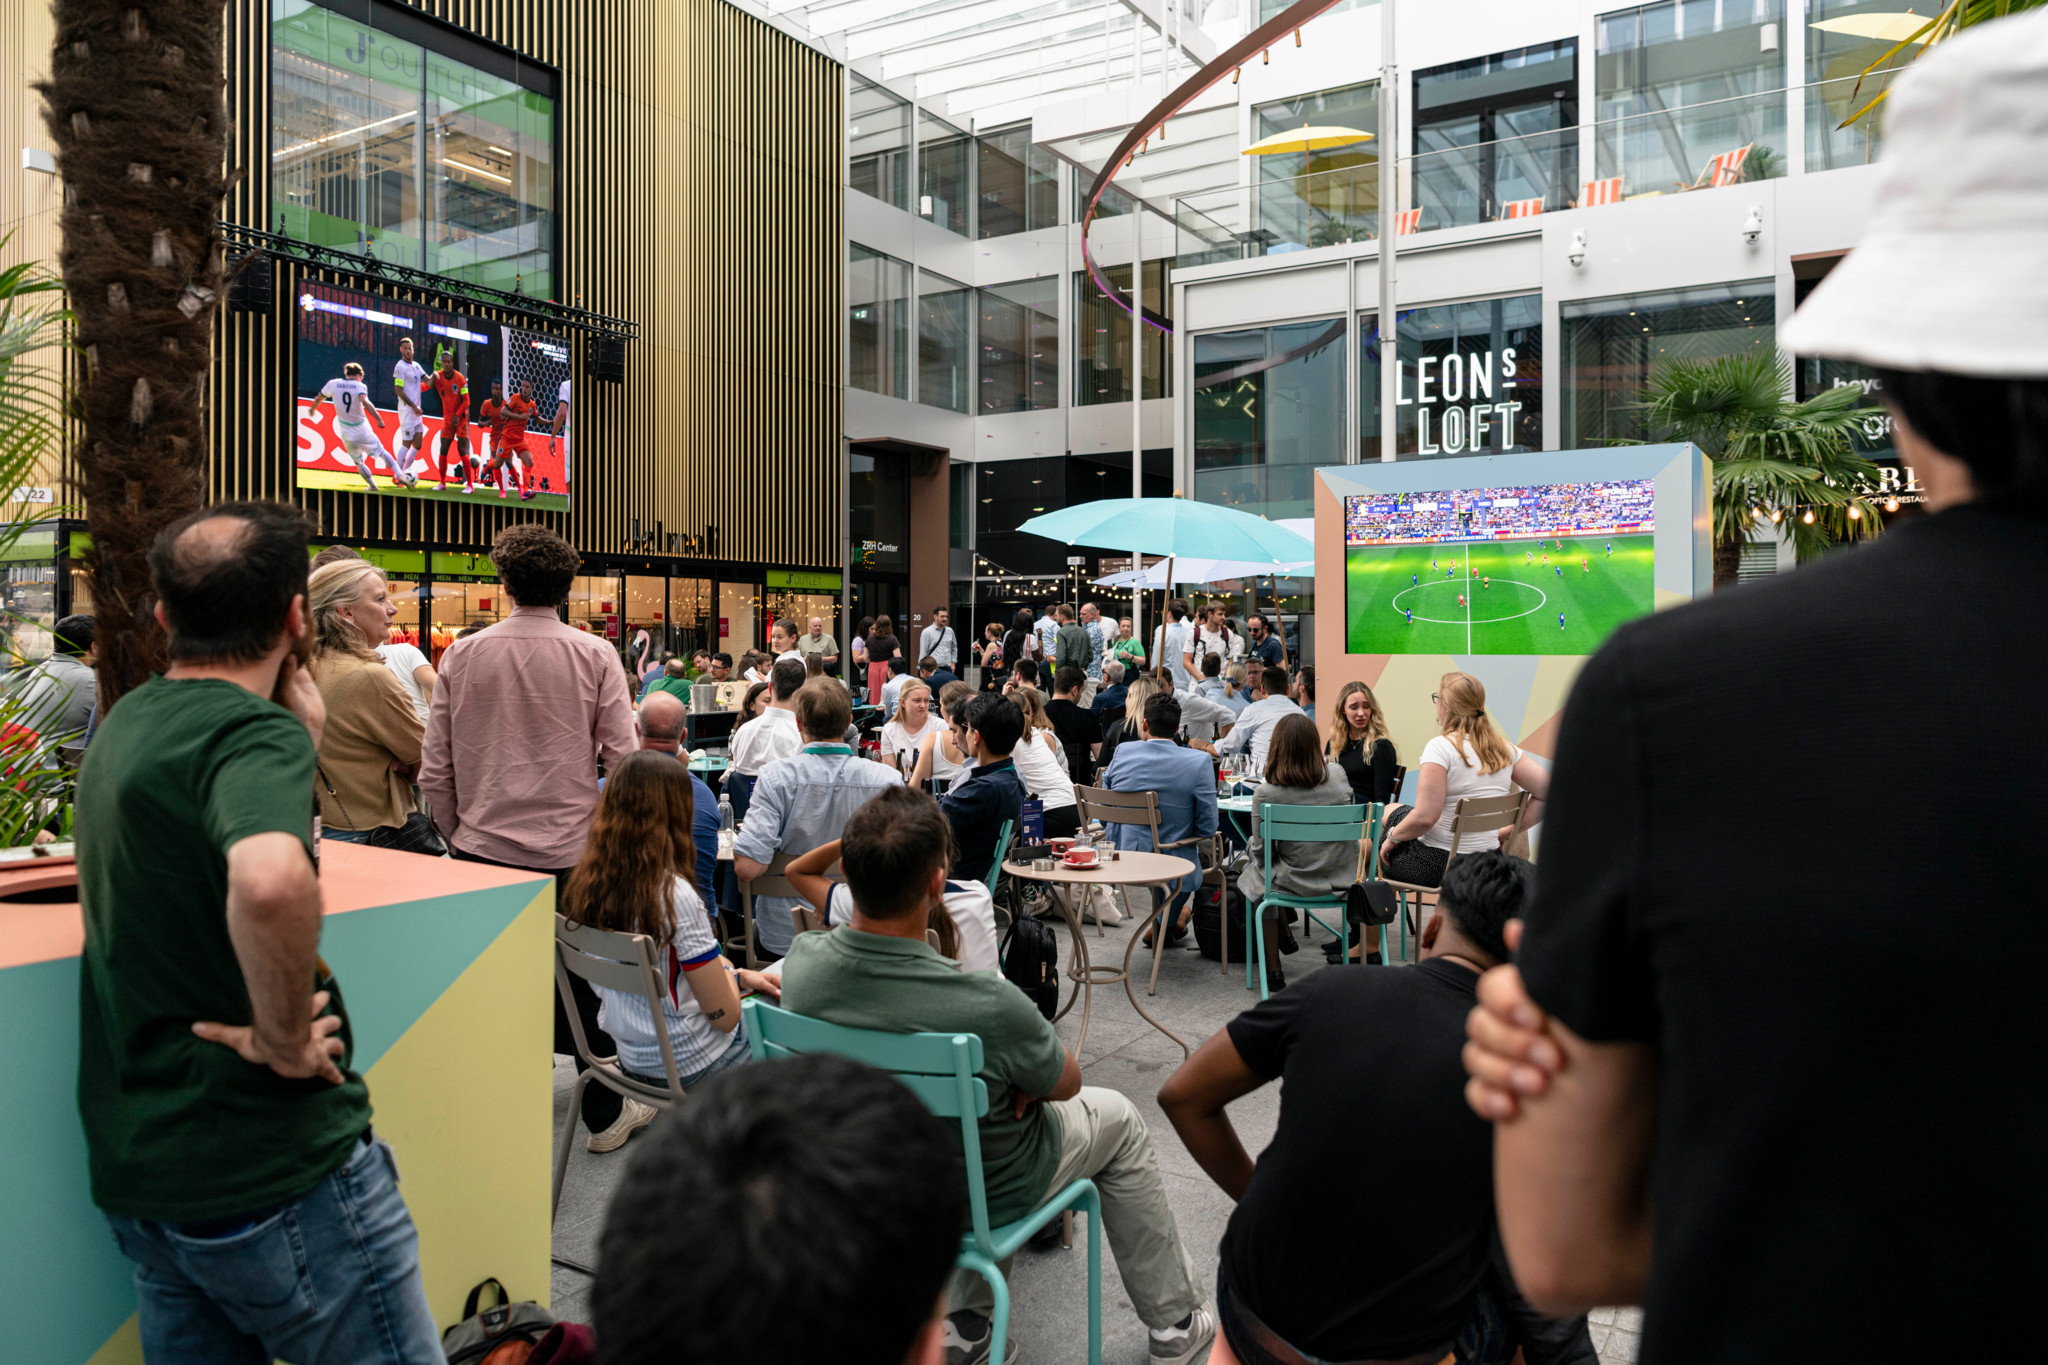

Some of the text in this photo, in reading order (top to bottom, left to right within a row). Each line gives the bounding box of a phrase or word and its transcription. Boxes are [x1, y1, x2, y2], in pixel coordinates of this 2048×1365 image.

[381, 45, 491, 105] OUTLET
[342, 391, 352, 414] 9
[1417, 401, 1522, 456] LOFT
[31, 489, 45, 499] 22
[1521, 497, 1535, 505] AUT
[862, 540, 899, 553] ZRH Center
[387, 572, 420, 581] EN MEN
[436, 574, 451, 582] MEN
[458, 575, 473, 583] MEN
[793, 575, 822, 586] OUTLET
[986, 583, 1052, 598] 7TH SPACE
[913, 613, 922, 621] 20
